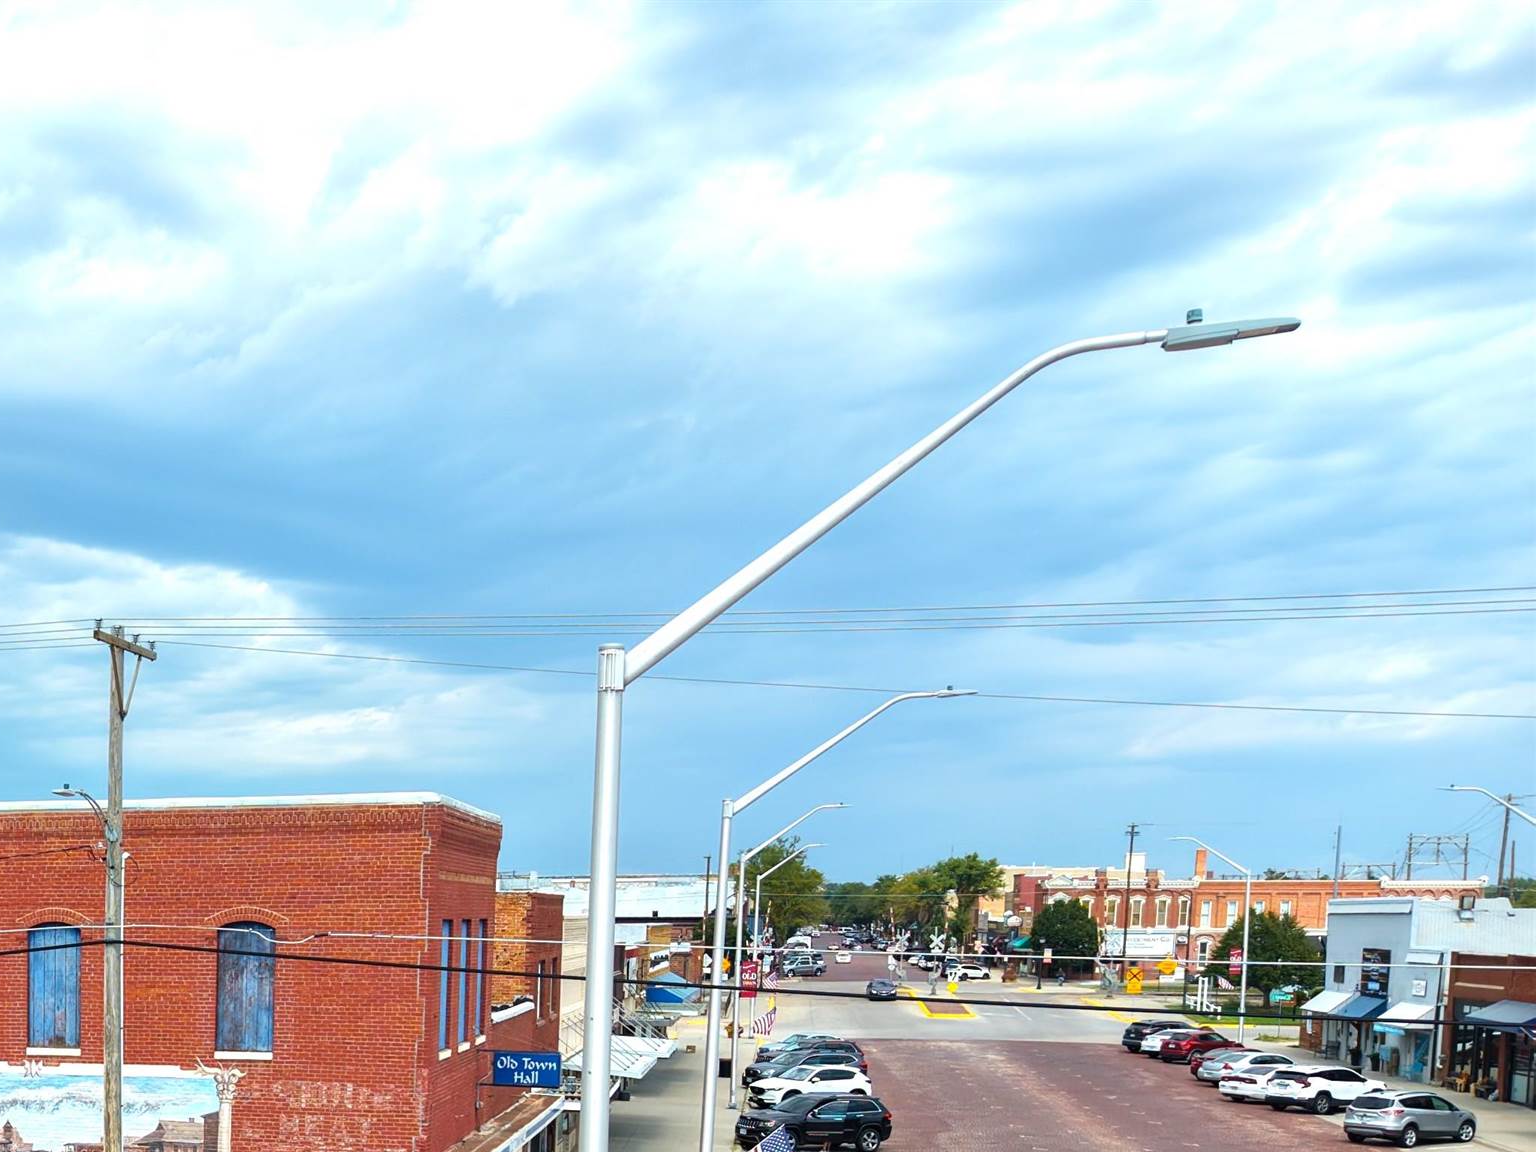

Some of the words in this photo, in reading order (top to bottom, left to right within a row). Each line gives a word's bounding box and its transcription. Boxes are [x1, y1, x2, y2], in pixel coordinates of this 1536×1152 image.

[497, 1055, 518, 1070] Old
[522, 1057, 557, 1071] Town
[513, 1070, 539, 1084] Hall
